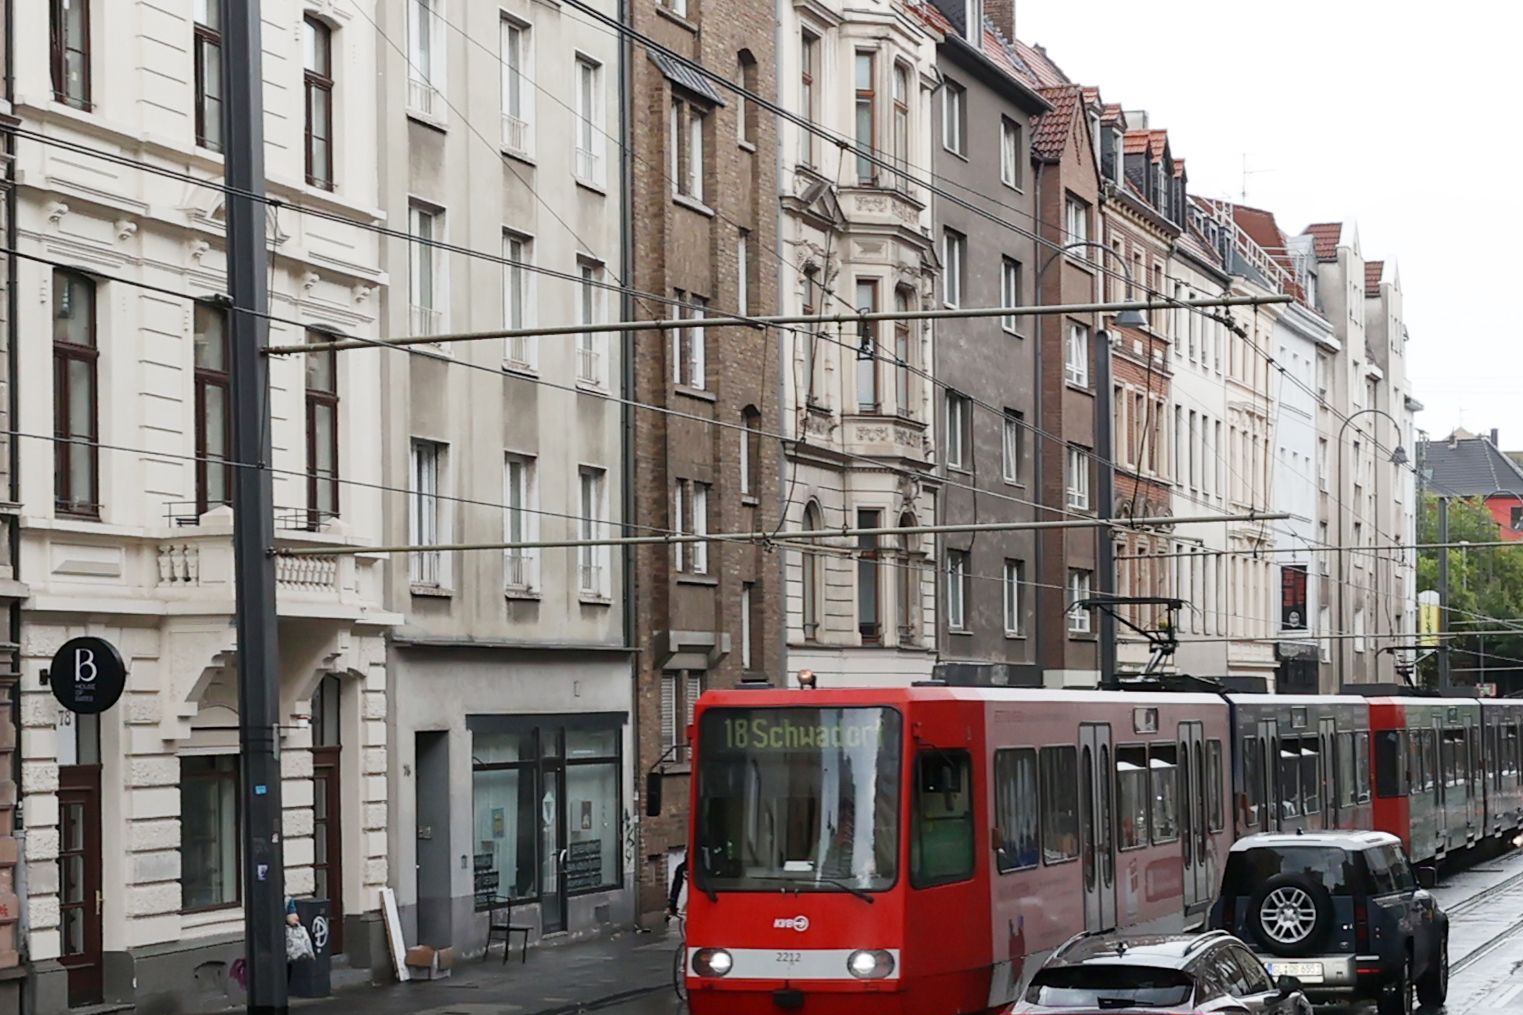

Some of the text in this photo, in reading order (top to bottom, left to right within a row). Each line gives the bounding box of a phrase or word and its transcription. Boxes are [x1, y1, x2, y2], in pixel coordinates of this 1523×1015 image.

[75, 648, 97, 682] B
[58, 710, 71, 726] 78
[724, 718, 885, 748] 18 Schwadorf
[776, 952, 801, 962] 2212
